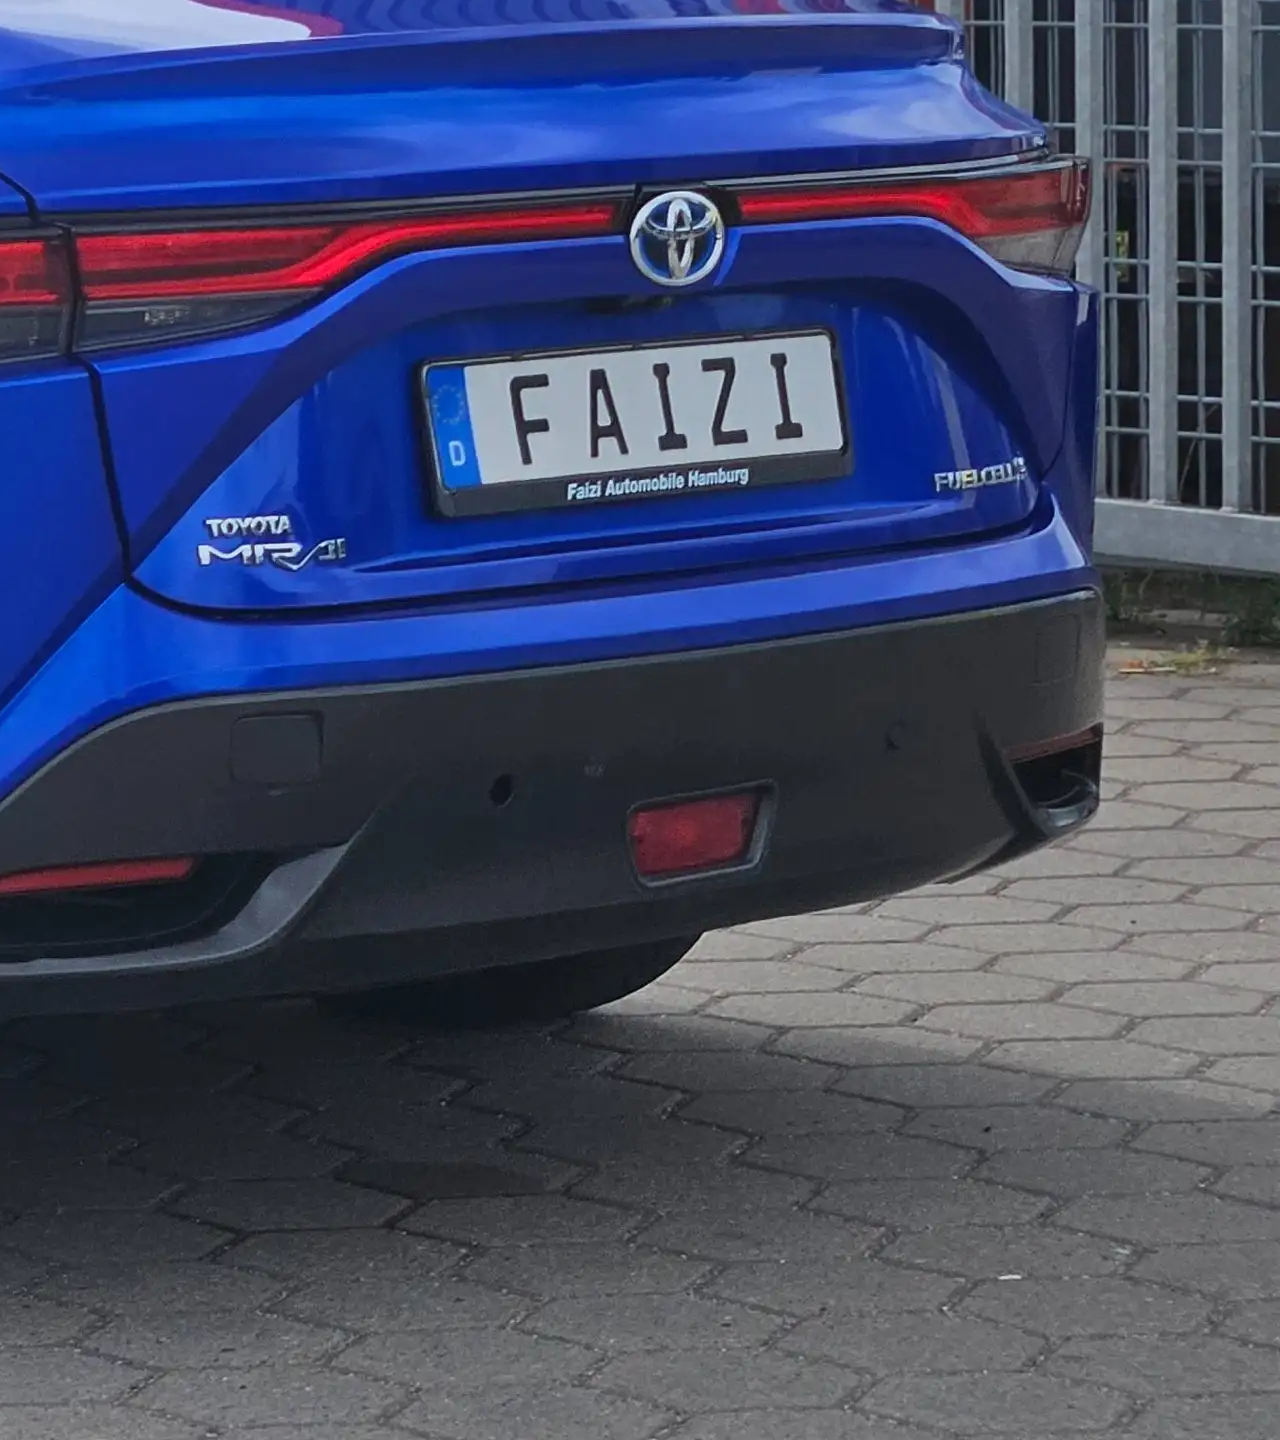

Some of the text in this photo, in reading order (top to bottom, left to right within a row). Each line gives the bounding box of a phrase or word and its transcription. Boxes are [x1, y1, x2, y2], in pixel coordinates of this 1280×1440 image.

[509, 353, 803, 465] FAIZI
[448, 441, 466, 466] D
[567, 467, 749, 500] Faizi Automobile Hamburg
[205, 515, 290, 537] TOYOTA
